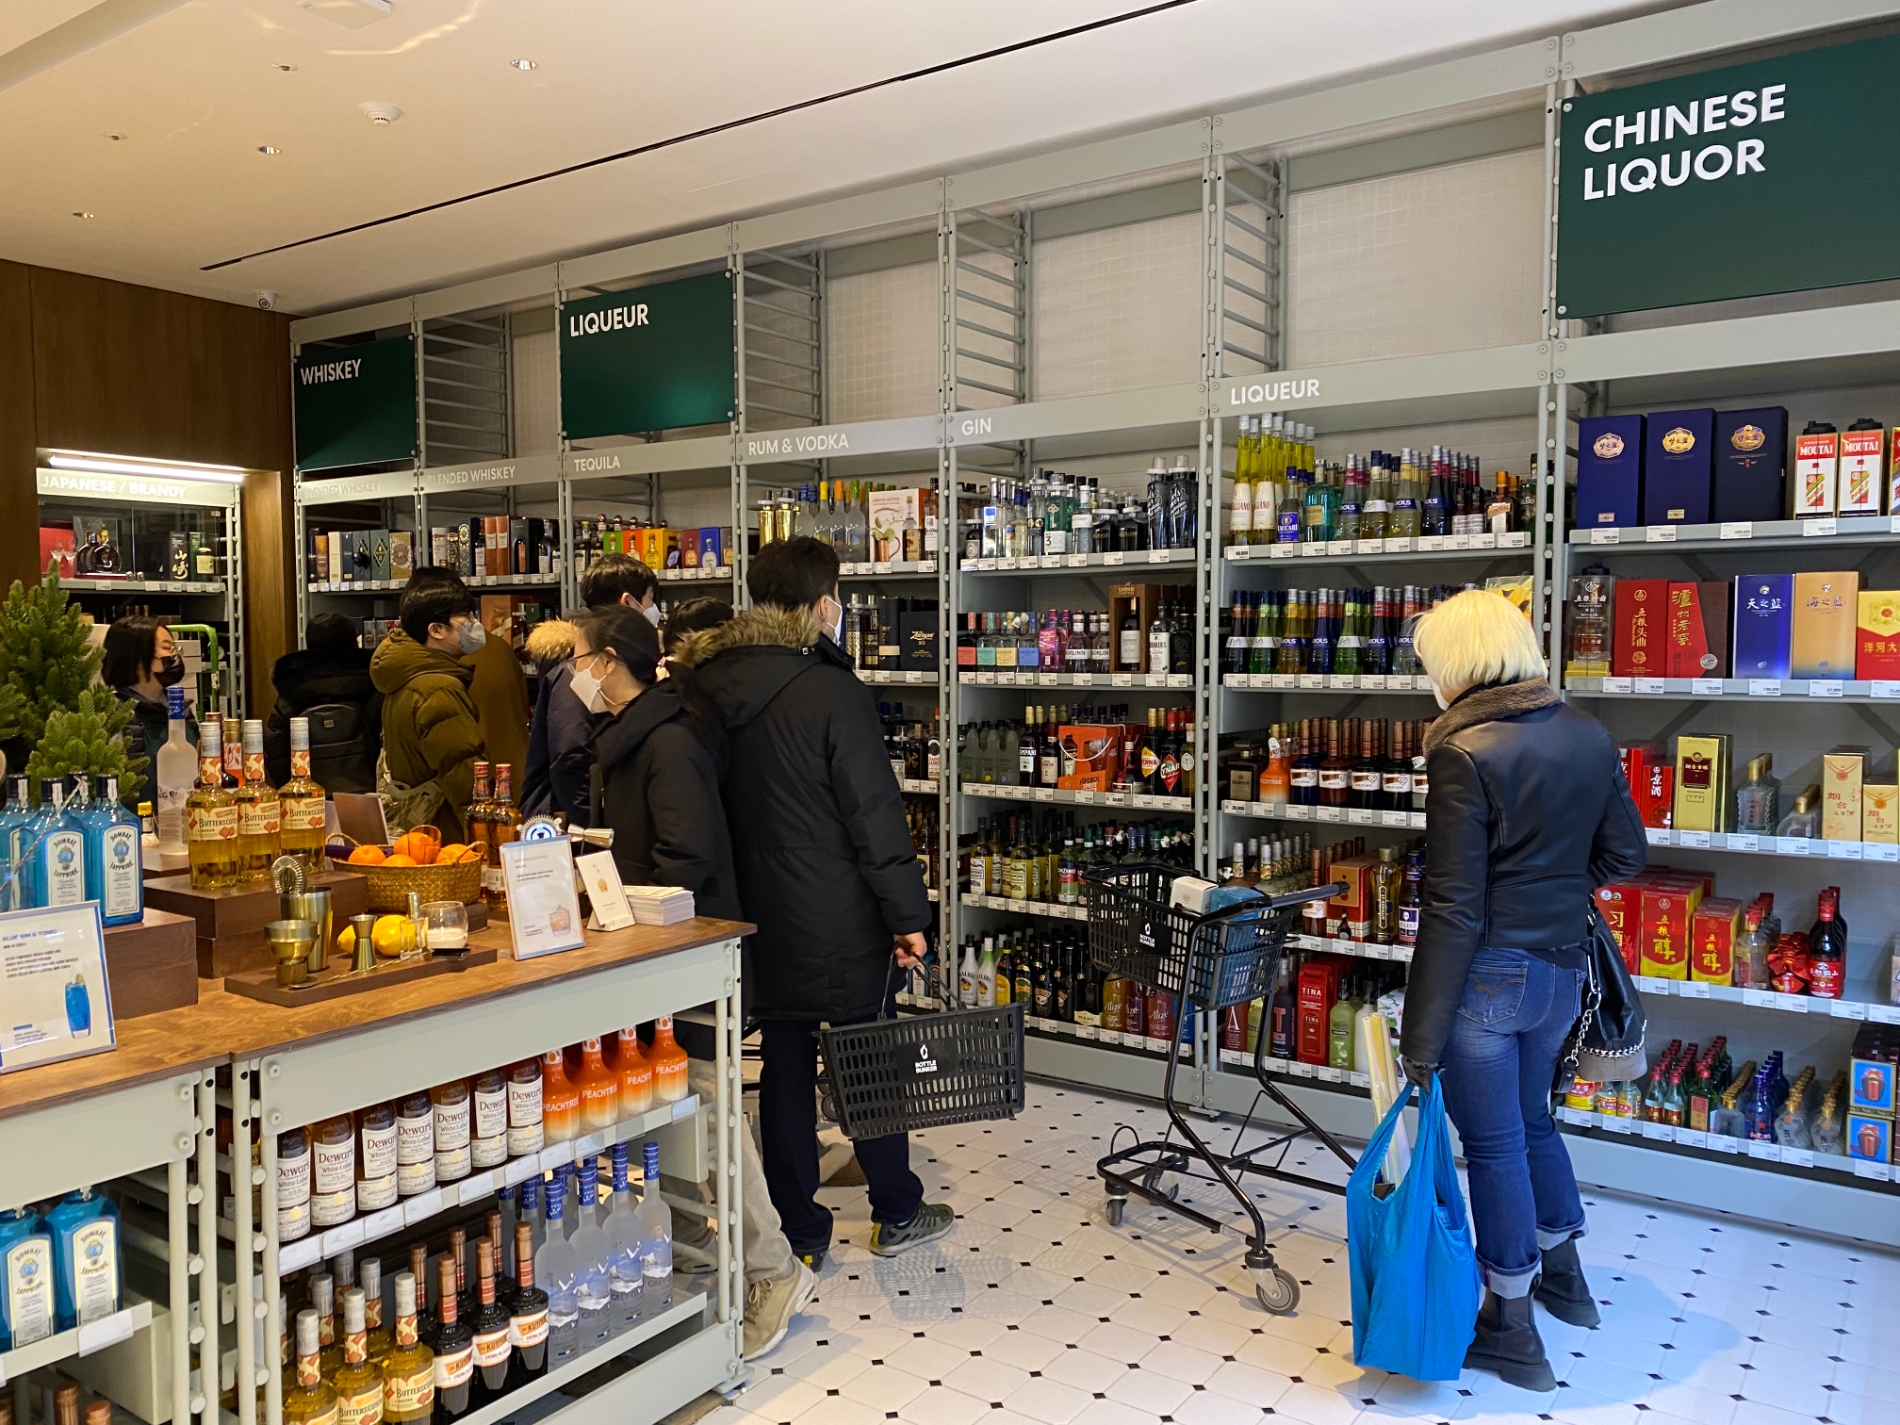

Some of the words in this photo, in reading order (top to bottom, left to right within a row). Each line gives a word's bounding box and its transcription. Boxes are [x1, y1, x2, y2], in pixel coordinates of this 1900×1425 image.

[1584, 83, 1786, 153] CHINESE
[1584, 138, 1766, 201] LIQUOR
[569, 303, 649, 337] LIQUEUR
[301, 358, 362, 386] WHISKEY
[1230, 378, 1320, 405] LIQUEUR
[961, 417, 992, 436] GIN
[748, 439, 779, 456] RUM
[781, 438, 793, 453] &
[796, 432, 849, 453] VODKA
[1800, 444, 1834, 456] MOUTAI
[1844, 441, 1879, 453] MOUTAI
[573, 455, 621, 473] TEQUILA
[427, 470, 469, 486] BLENDED
[470, 465, 516, 482] WHISKEY
[41, 475, 116, 493] JAPANESE
[118, 481, 126, 494] /
[129, 482, 187, 498] BRANDY
[304, 482, 339, 500] BLENDED
[341, 480, 379, 495] WHISKEY
[1045, 537, 1052, 547] 3
[1864, 641, 1900, 653] 洋河大
[1302, 987, 1322, 997] TINA
[1305, 1015, 1320, 1023] TINA
[915, 1060, 937, 1068] BOTTLE
[916, 1066, 938, 1074] BUNKER
[611, 1292, 629, 1301] GREY
